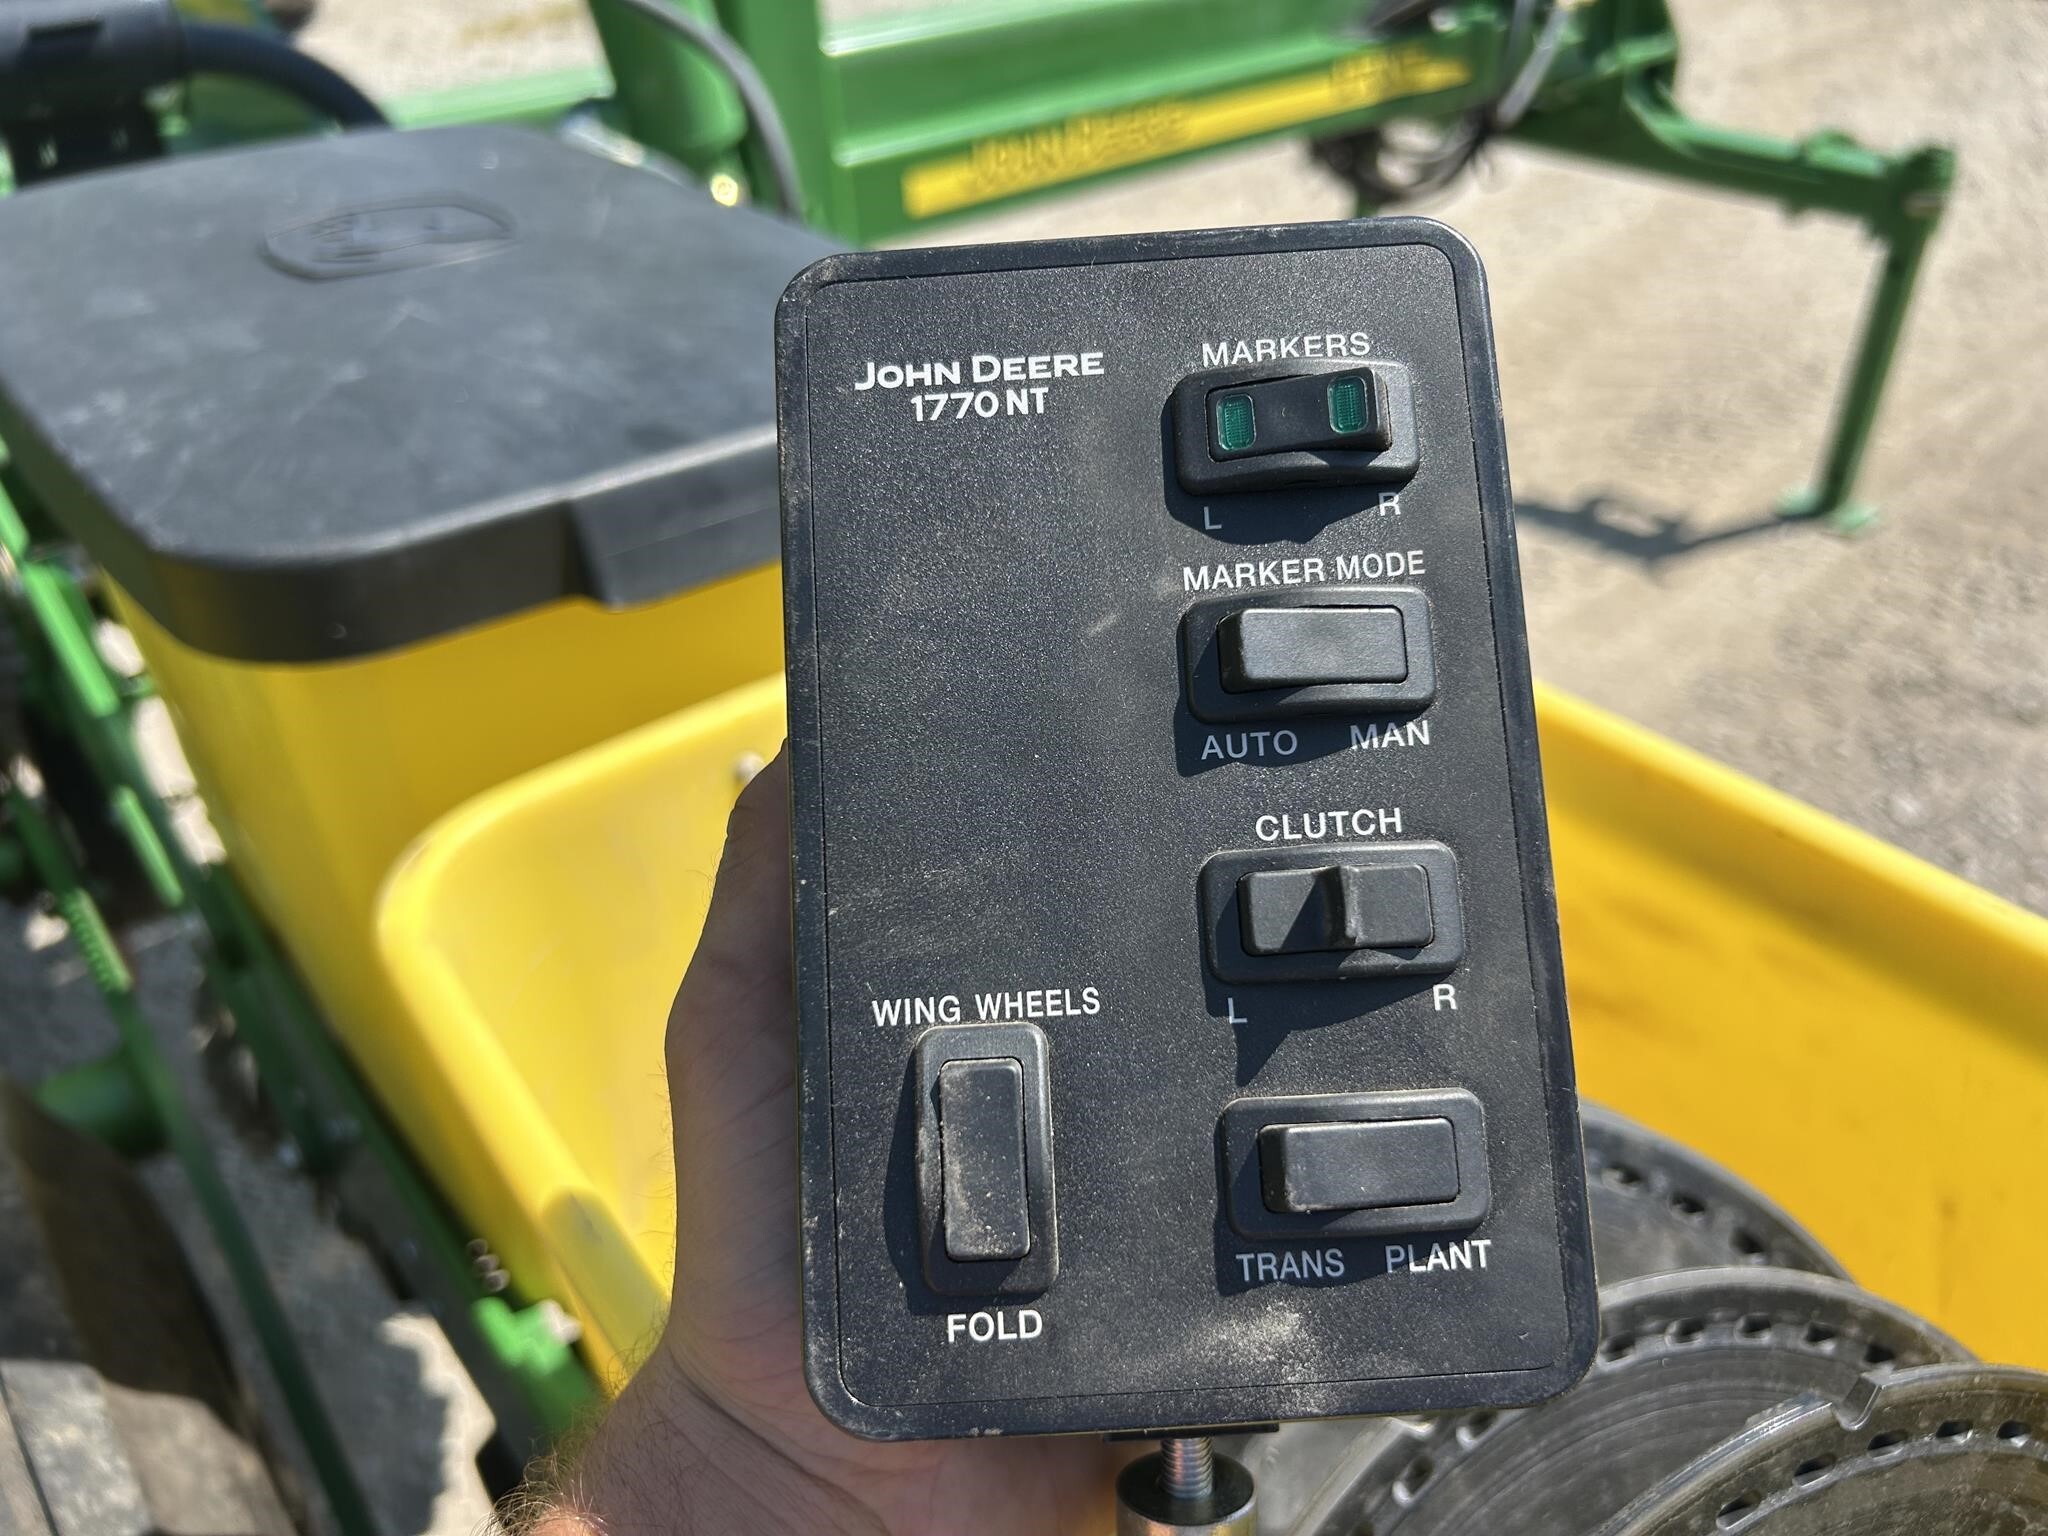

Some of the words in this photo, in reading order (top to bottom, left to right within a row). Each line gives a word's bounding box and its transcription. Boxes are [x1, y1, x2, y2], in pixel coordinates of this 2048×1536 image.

[1202, 331, 1371, 367] MARKERS
[854, 362, 961, 391] JOHN
[971, 352, 1105, 383] DEERE
[1204, 506, 1222, 530] L
[1379, 492, 1402, 516] R
[1183, 559, 1326, 591] MARKER
[1337, 550, 1426, 580] MODE
[1201, 729, 1298, 760] AUTO
[1350, 720, 1431, 750] MAN
[1255, 808, 1402, 841] CLUTCH
[872, 995, 961, 1027] WING
[975, 986, 1100, 1021] WHEELS
[1228, 998, 1247, 1024] L
[1433, 984, 1458, 1011] R
[1236, 1248, 1345, 1282] TRANS
[1385, 1240, 1492, 1273] PLANT
[947, 1310, 1043, 1343] FOLD
